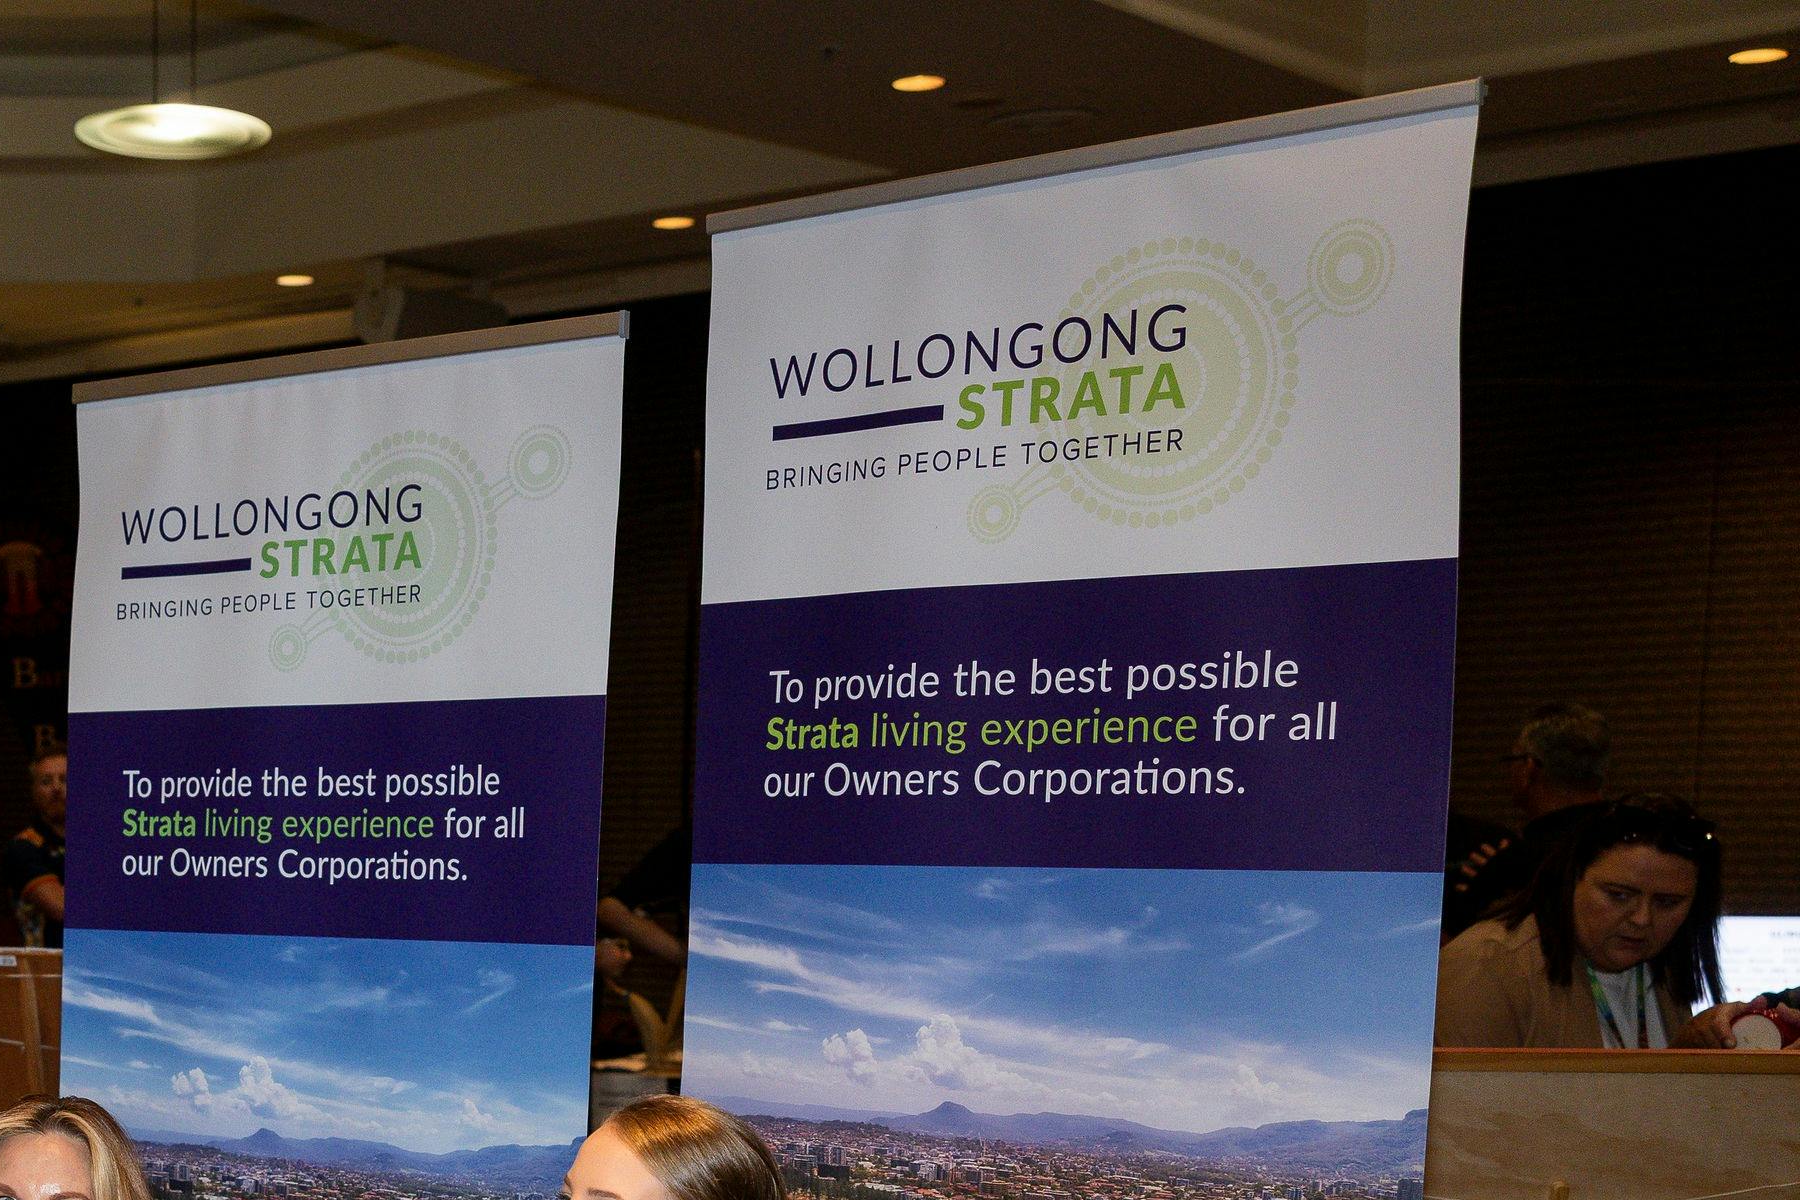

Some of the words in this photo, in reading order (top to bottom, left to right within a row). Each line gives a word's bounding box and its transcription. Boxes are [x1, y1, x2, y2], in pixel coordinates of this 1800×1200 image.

[769, 304, 1186, 399] WOLLONGONG
[956, 363, 1185, 431] STRATA
[766, 457, 886, 491] BRINGING
[898, 444, 1007, 476] PEOPLE
[1022, 429, 1183, 467] TOGETHER
[121, 484, 423, 545] WOLLONGONG
[260, 531, 422, 579] STRATA
[117, 598, 213, 620] BRINGING
[221, 592, 295, 615] PEOPLE
[307, 584, 421, 610] TOGETHER
[770, 670, 803, 704] To
[814, 663, 939, 709] provide
[954, 660, 1016, 696] the
[1031, 658, 1112, 695] best
[1126, 651, 1299, 699] possible
[766, 714, 858, 751] Strata
[871, 712, 967, 755] living
[981, 708, 1198, 752] experience
[1212, 705, 1272, 742] for
[1288, 702, 1337, 741] all
[123, 769, 152, 798] To
[161, 768, 252, 803] provide
[261, 768, 307, 796] the
[318, 767, 376, 796] best
[385, 764, 500, 802] possible
[764, 768, 814, 798] our
[824, 761, 959, 796] Owners
[974, 758, 1245, 802] Corporations.
[123, 809, 196, 837] Strata
[205, 808, 272, 843] living
[283, 809, 433, 843] experience
[444, 808, 486, 838] for
[494, 807, 525, 838] all
[122, 854, 163, 877] our
[170, 849, 268, 878] Owners
[278, 850, 467, 885] Corporations.
